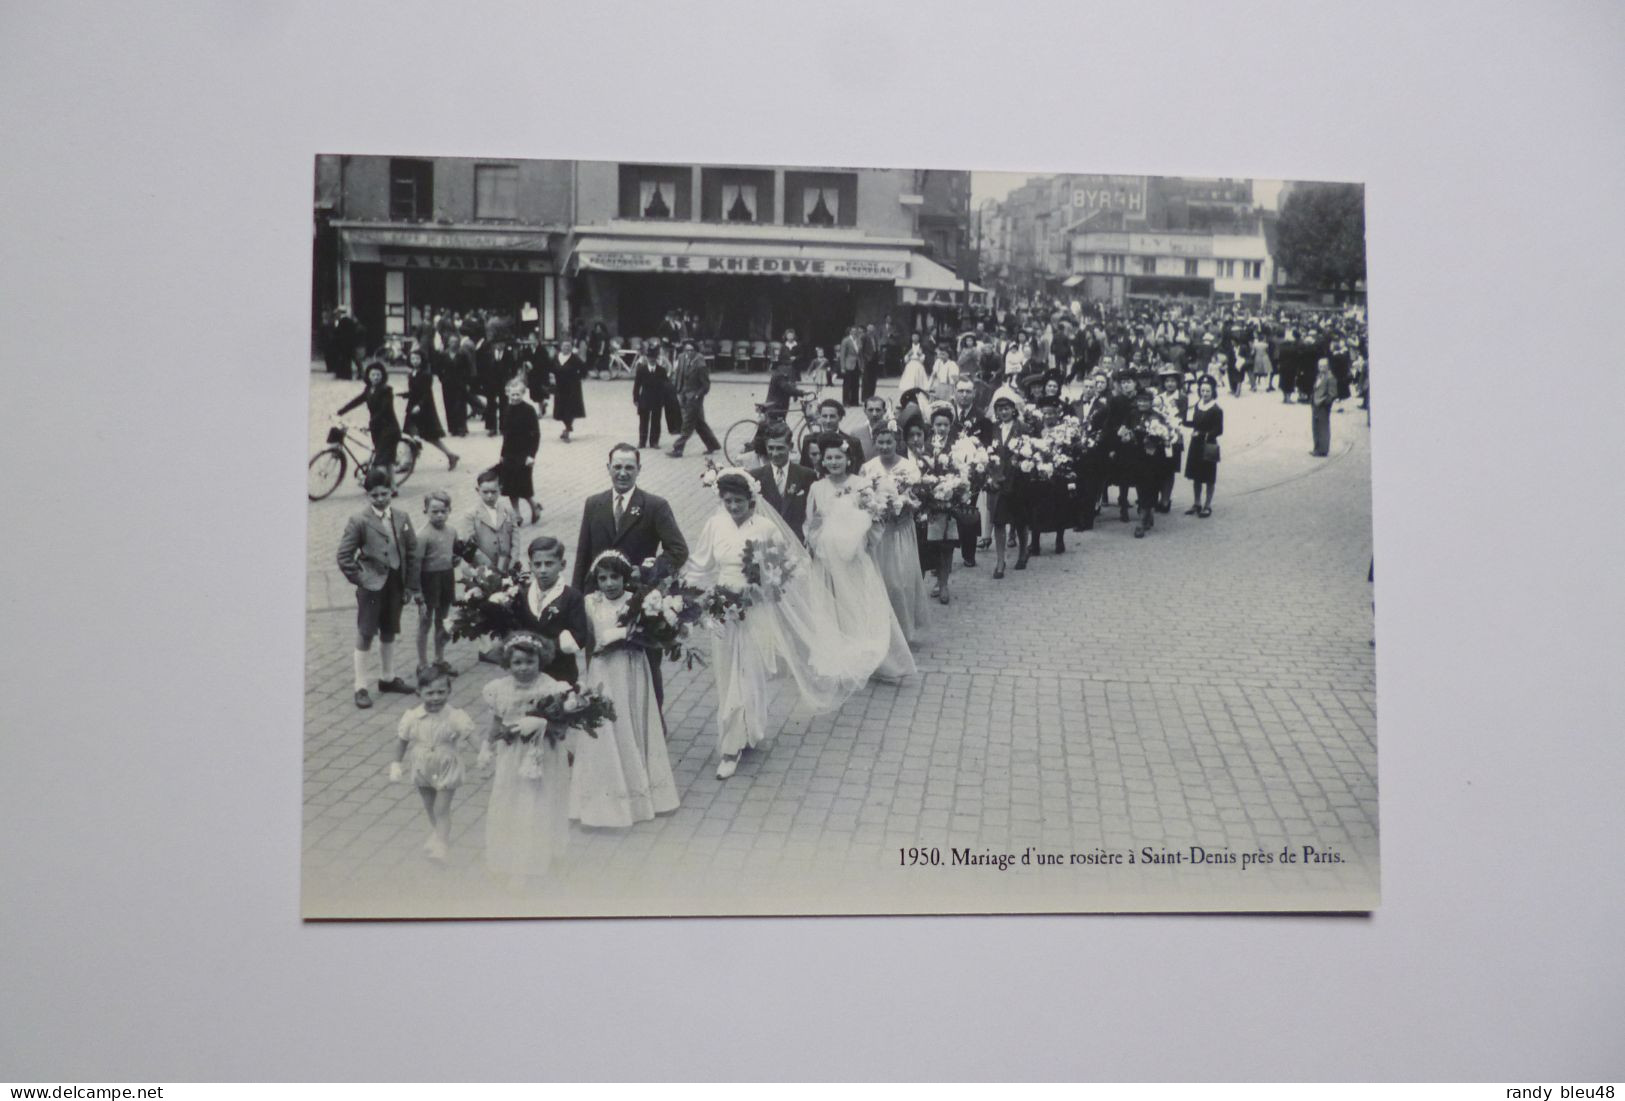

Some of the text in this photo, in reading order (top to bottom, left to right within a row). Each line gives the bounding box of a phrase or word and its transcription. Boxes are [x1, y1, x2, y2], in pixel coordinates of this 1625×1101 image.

[661, 256, 690, 269] LE
[708, 255, 825, 274] KHÉDIVE
[899, 846, 1345, 871] 1950. Mariage d'une rosière à Saint-Denis près de Paris.
